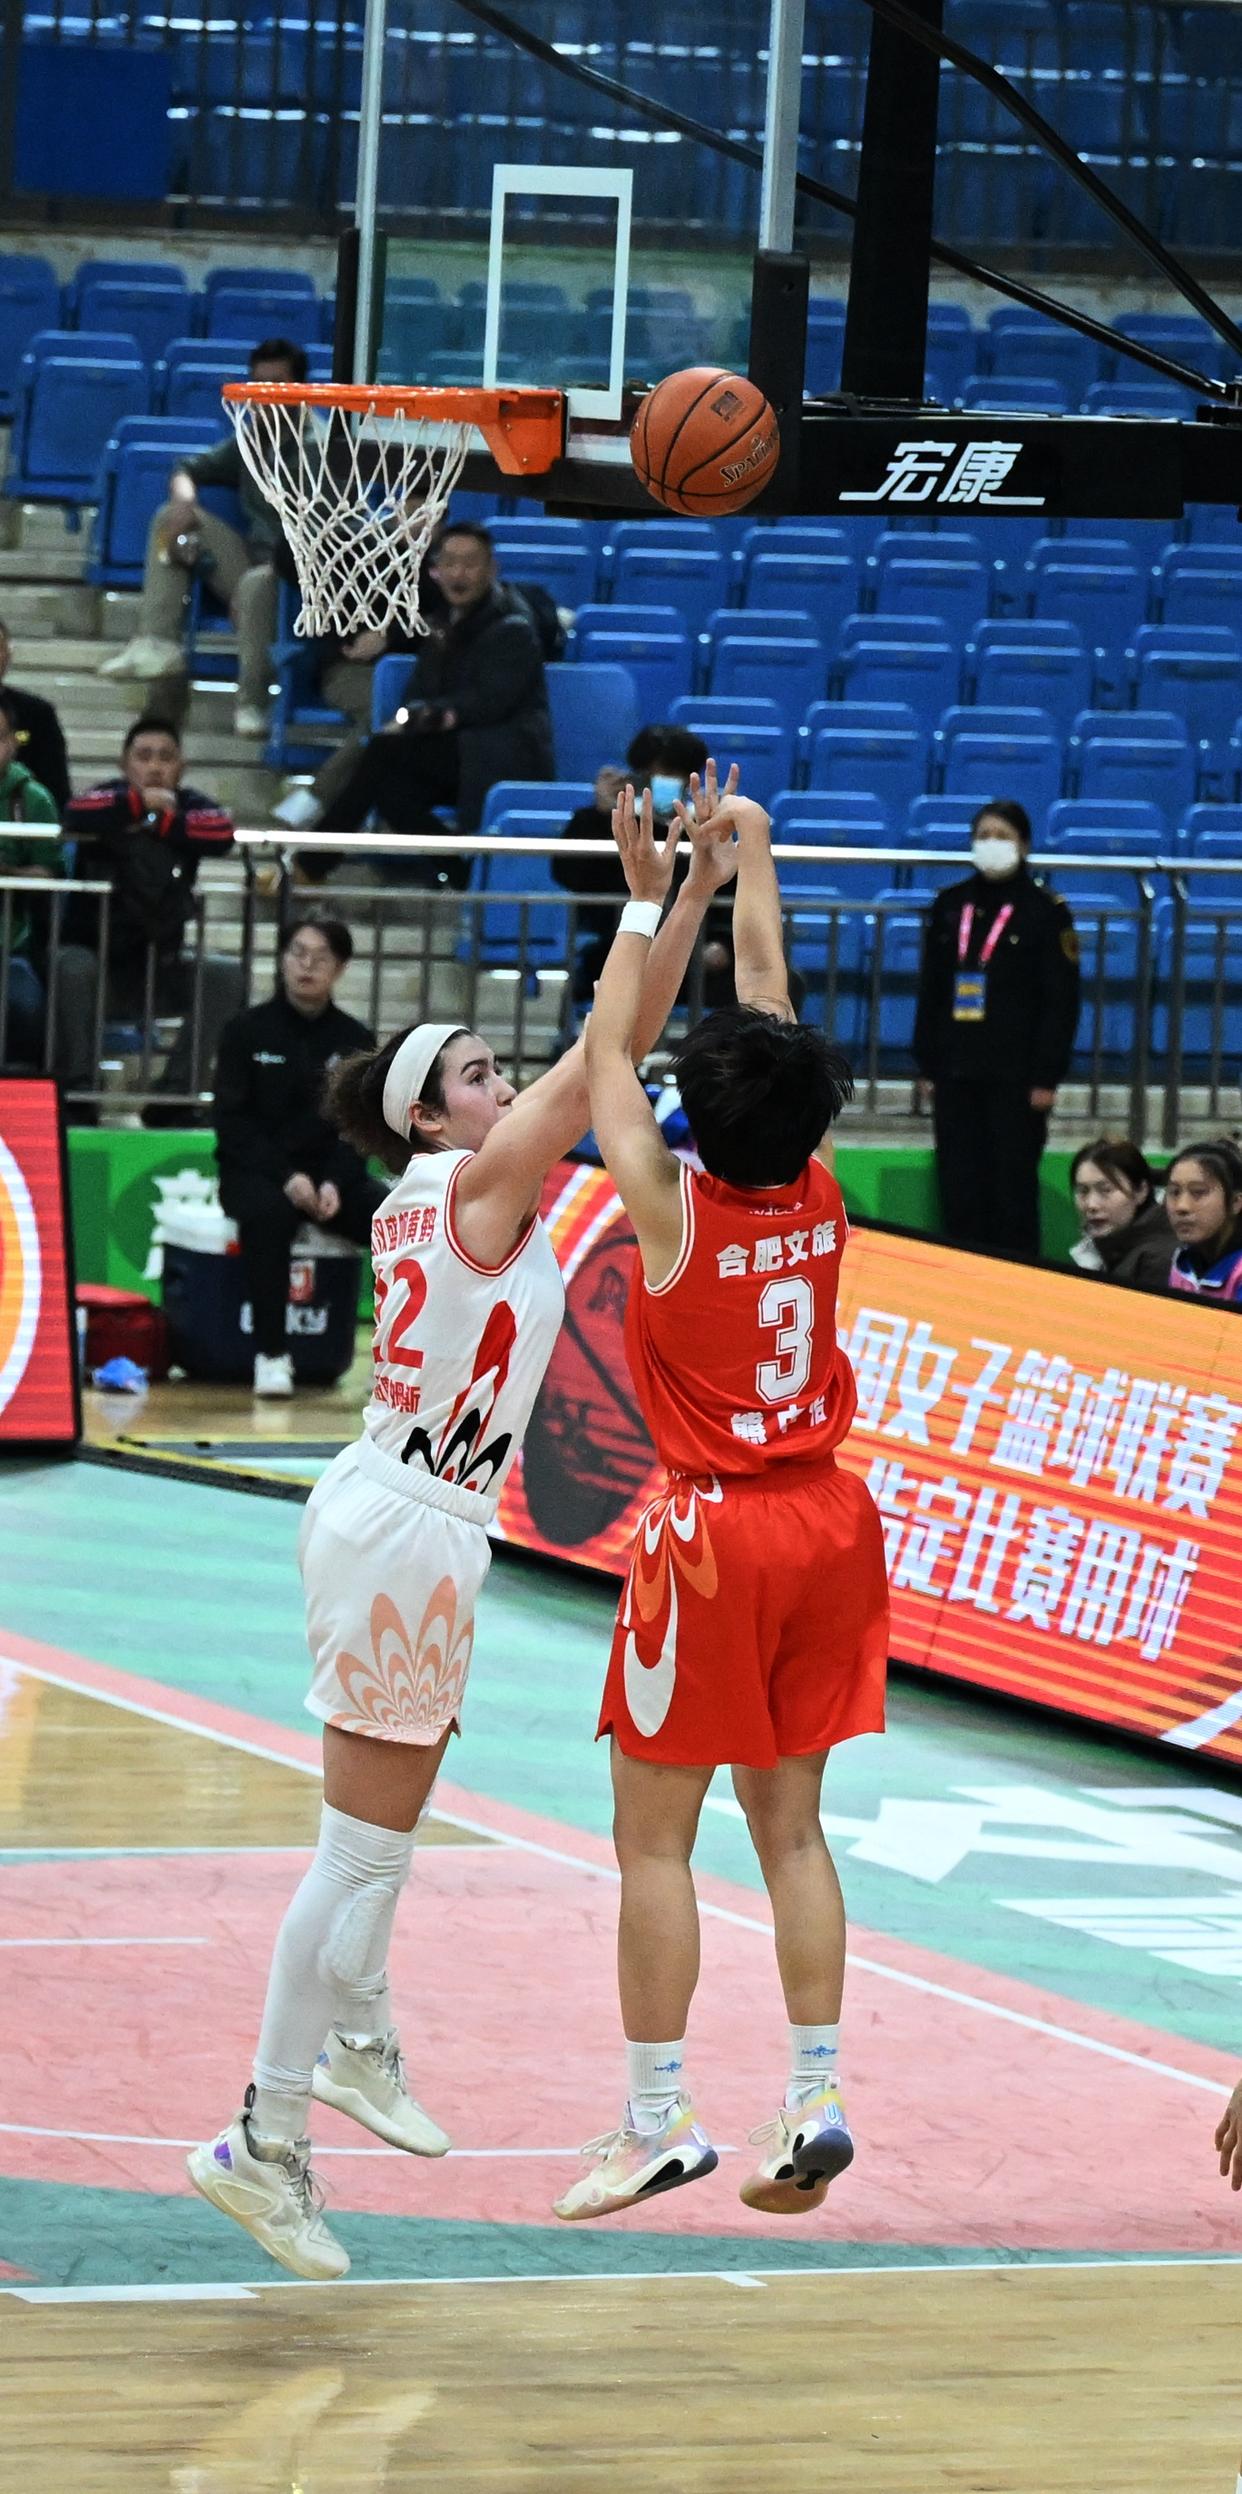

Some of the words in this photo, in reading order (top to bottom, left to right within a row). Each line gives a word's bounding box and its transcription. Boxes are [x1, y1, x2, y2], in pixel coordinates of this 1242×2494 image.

[838, 440, 1046, 506] 宏康
[716, 1219, 837, 1279] 合肥文旅
[756, 1274, 815, 1405] 3
[838, 1305, 1242, 1518] 国女子篮球联赛
[866, 1455, 1201, 1663] 指定比赛用球
